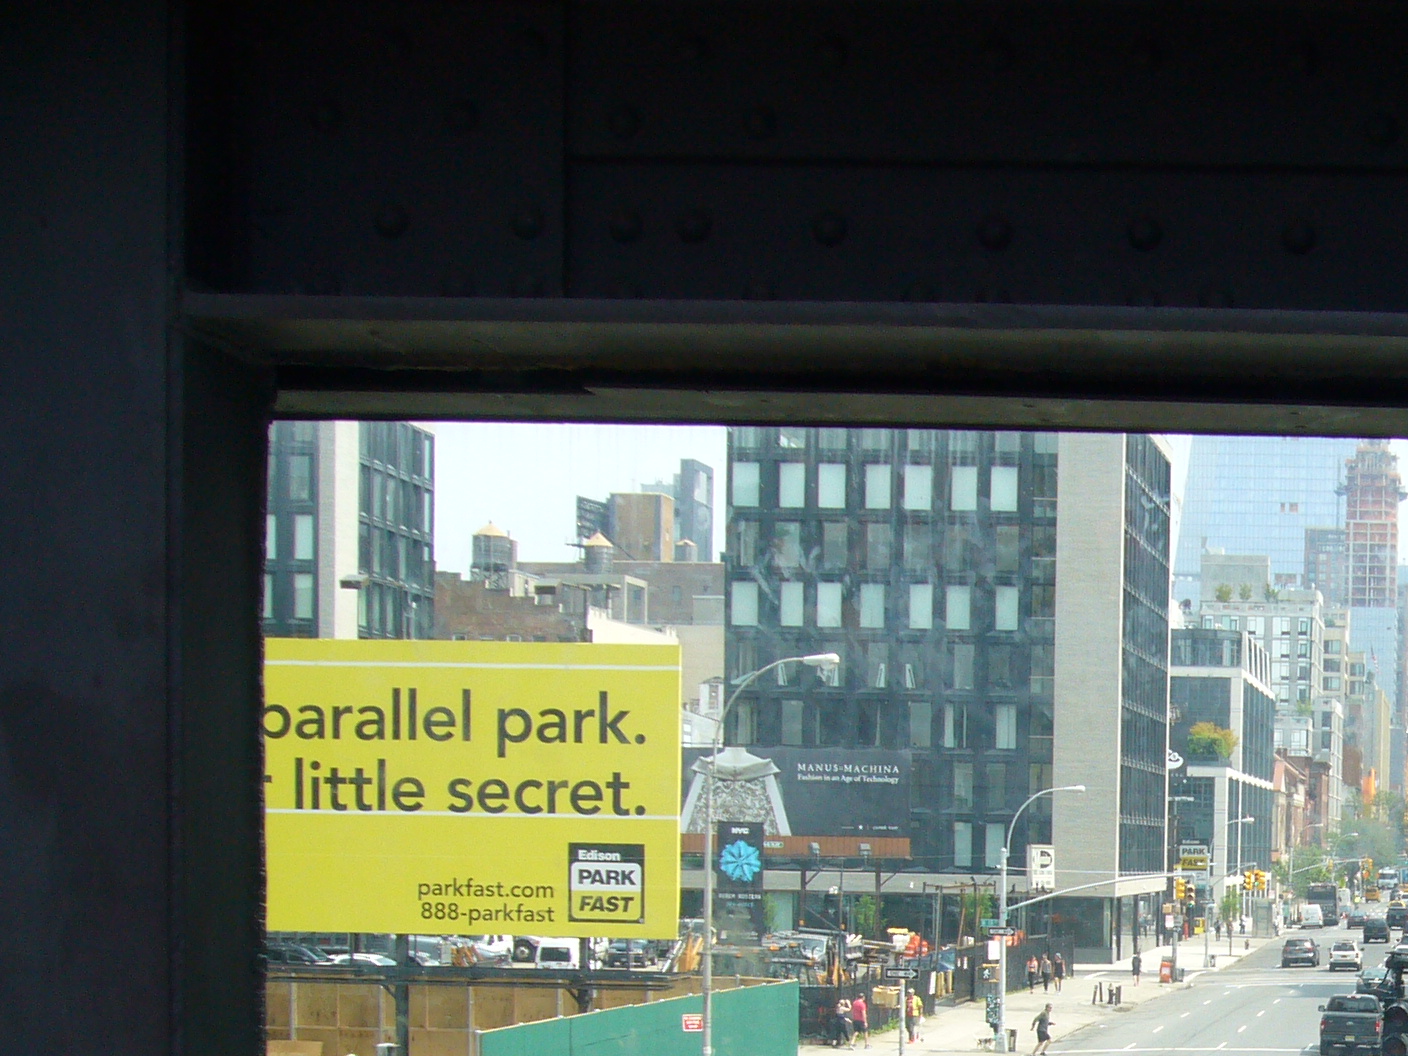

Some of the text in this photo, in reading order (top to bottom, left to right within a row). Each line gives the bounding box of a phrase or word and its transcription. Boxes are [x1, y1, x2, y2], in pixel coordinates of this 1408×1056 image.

[262, 687, 647, 758] parallel park.
[295, 757, 647, 816] little secret.
[578, 849, 621, 861] Edison
[1182, 847, 1206, 856] PARK
[578, 868, 637, 886] PARK
[418, 877, 555, 901] parkfast.com
[420, 901, 556, 926] 888-parkfast
[579, 895, 635, 913] FAST
